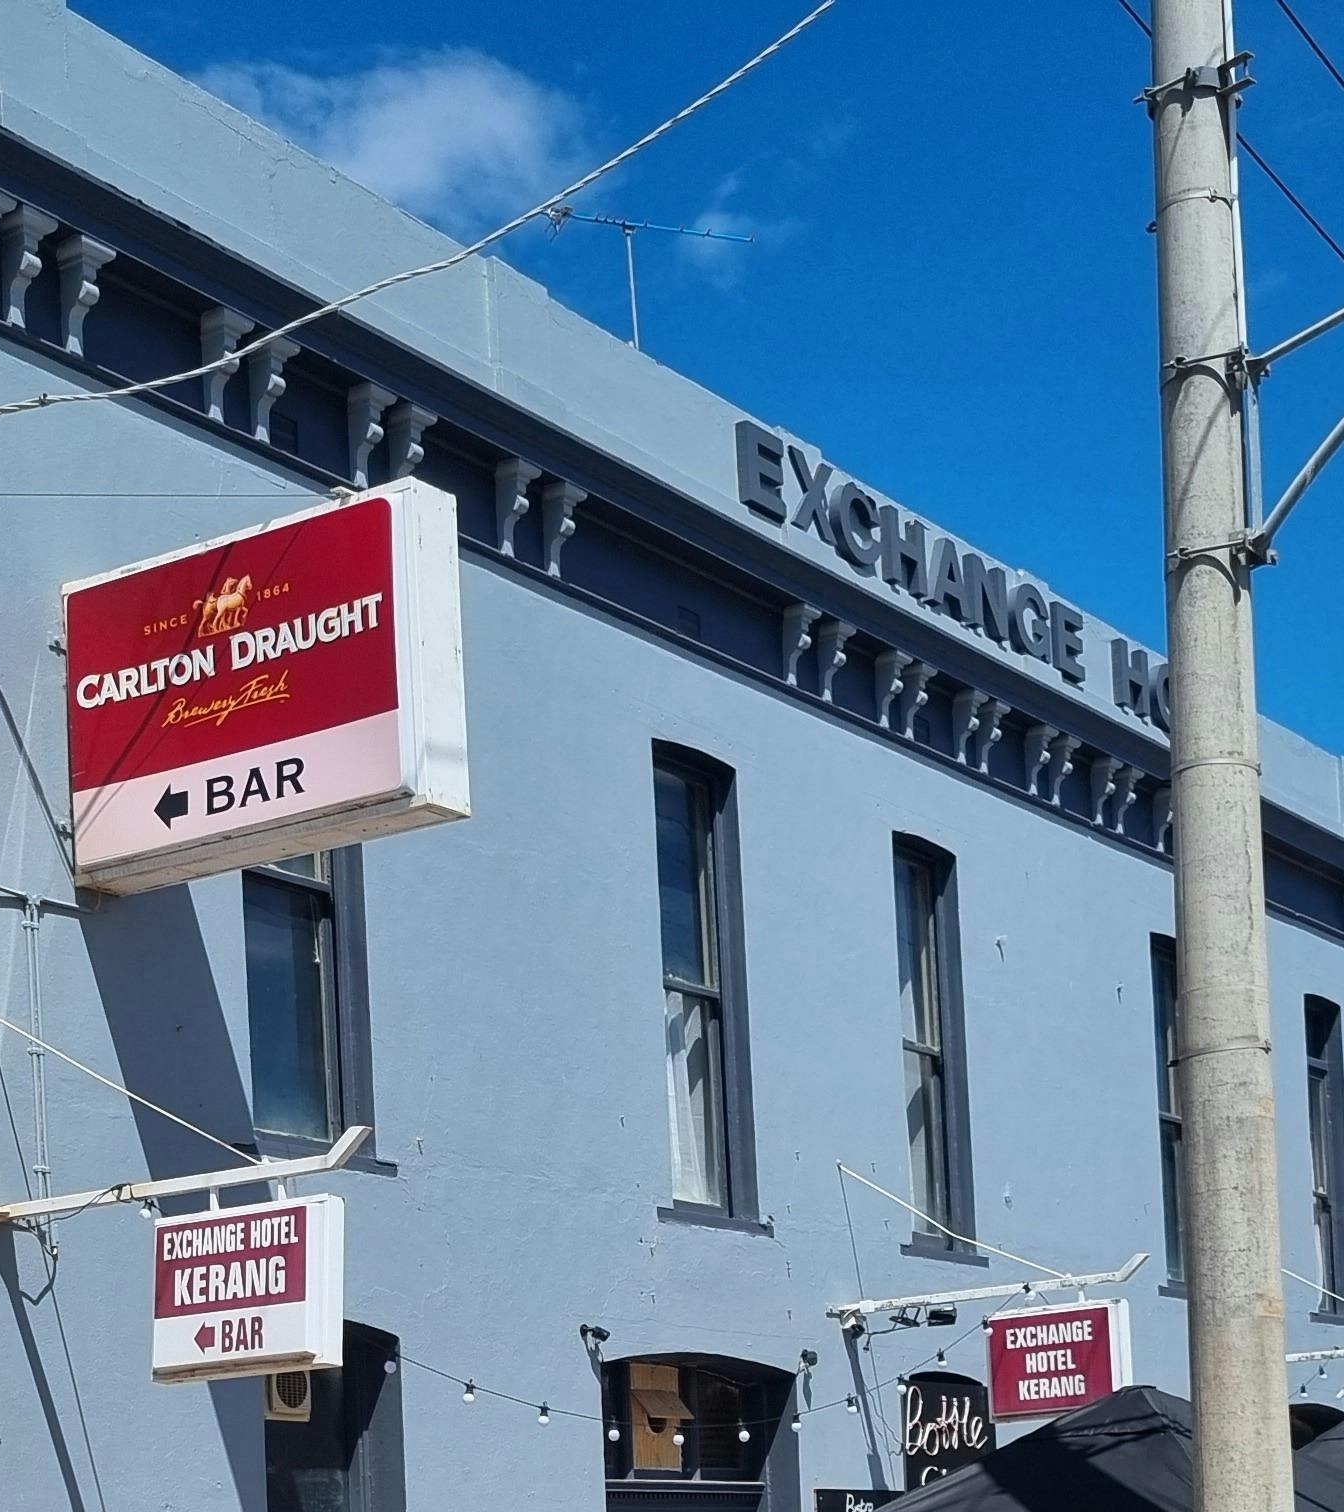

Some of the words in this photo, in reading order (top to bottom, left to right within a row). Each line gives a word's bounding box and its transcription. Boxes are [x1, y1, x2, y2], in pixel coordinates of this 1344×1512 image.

[735, 420, 1086, 689] EXCHANGE
[143, 614, 188, 635] SINCE
[257, 582, 290, 601] 1864
[76, 644, 216, 710] CARLTON
[230, 592, 383, 671] DRAUGHT
[162, 694, 238, 727] Brewery
[240, 669, 289, 703] Fresh
[205, 757, 305, 816] BAR
[163, 1222, 245, 1261] EXCHANGE
[250, 1215, 299, 1249] HOTEL
[174, 1256, 286, 1307] KERANG
[221, 1316, 264, 1354] BAR
[1006, 1319, 1093, 1349] EXCHANGE
[1018, 1374, 1086, 1401] KERANG
[1025, 1349, 1076, 1374] HOTEL
[907, 1385, 988, 1456] Bottle
